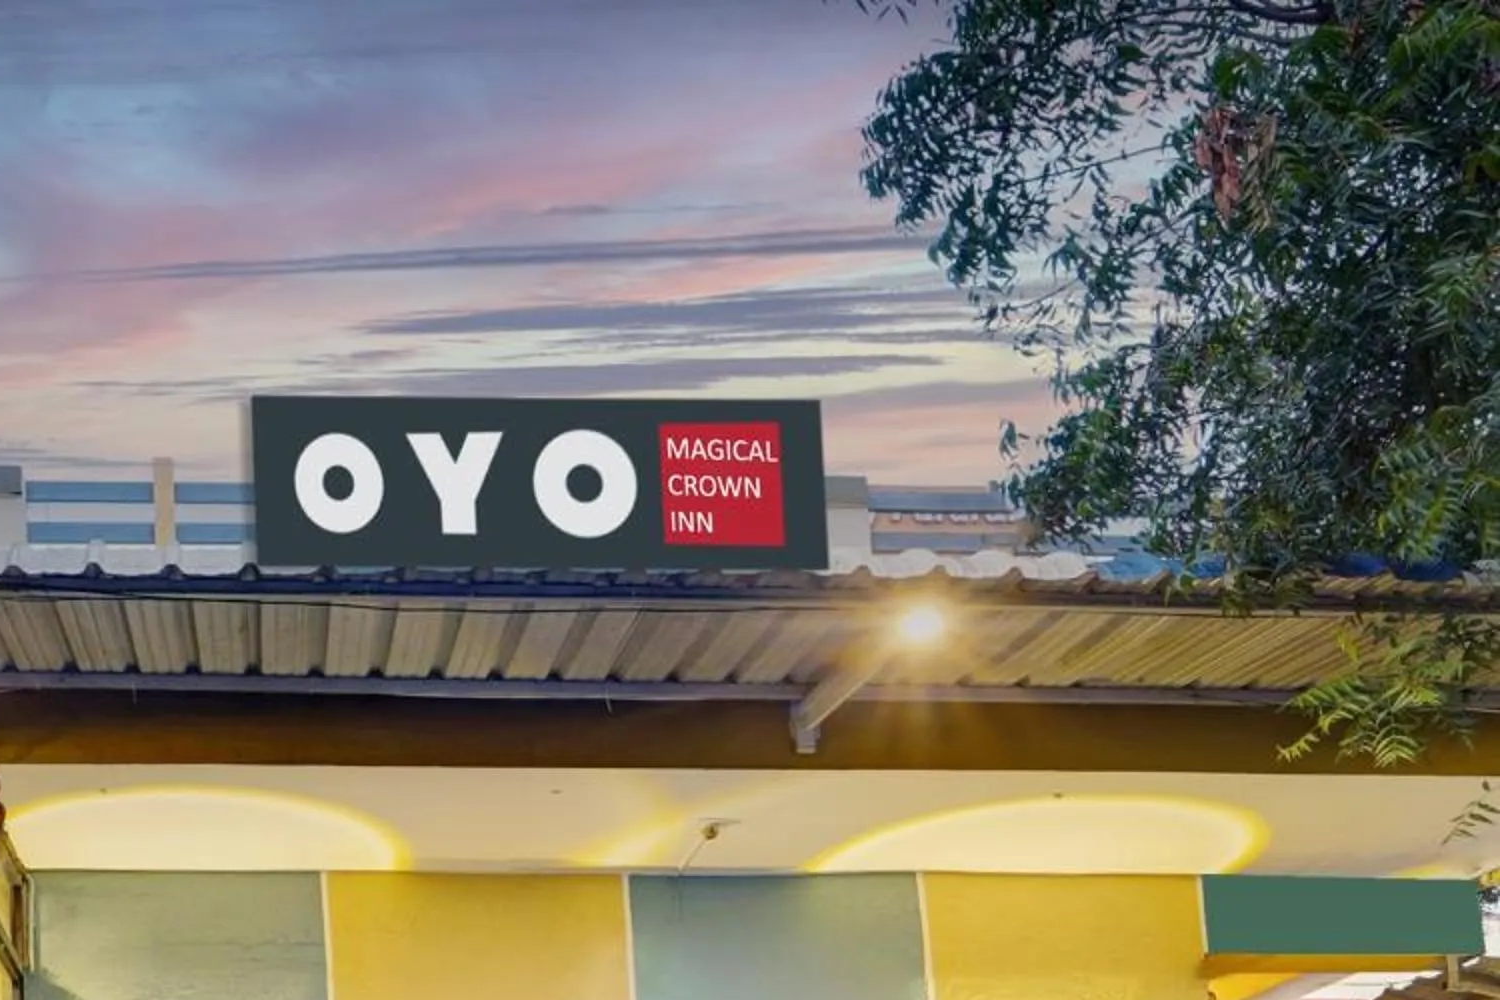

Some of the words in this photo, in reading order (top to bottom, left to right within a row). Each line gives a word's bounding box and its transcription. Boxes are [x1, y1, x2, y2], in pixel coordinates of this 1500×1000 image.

[667, 437, 779, 462] MAGICAL
[294, 429, 638, 538] OYO
[667, 474, 762, 499] CROWN
[670, 511, 713, 533] INN
